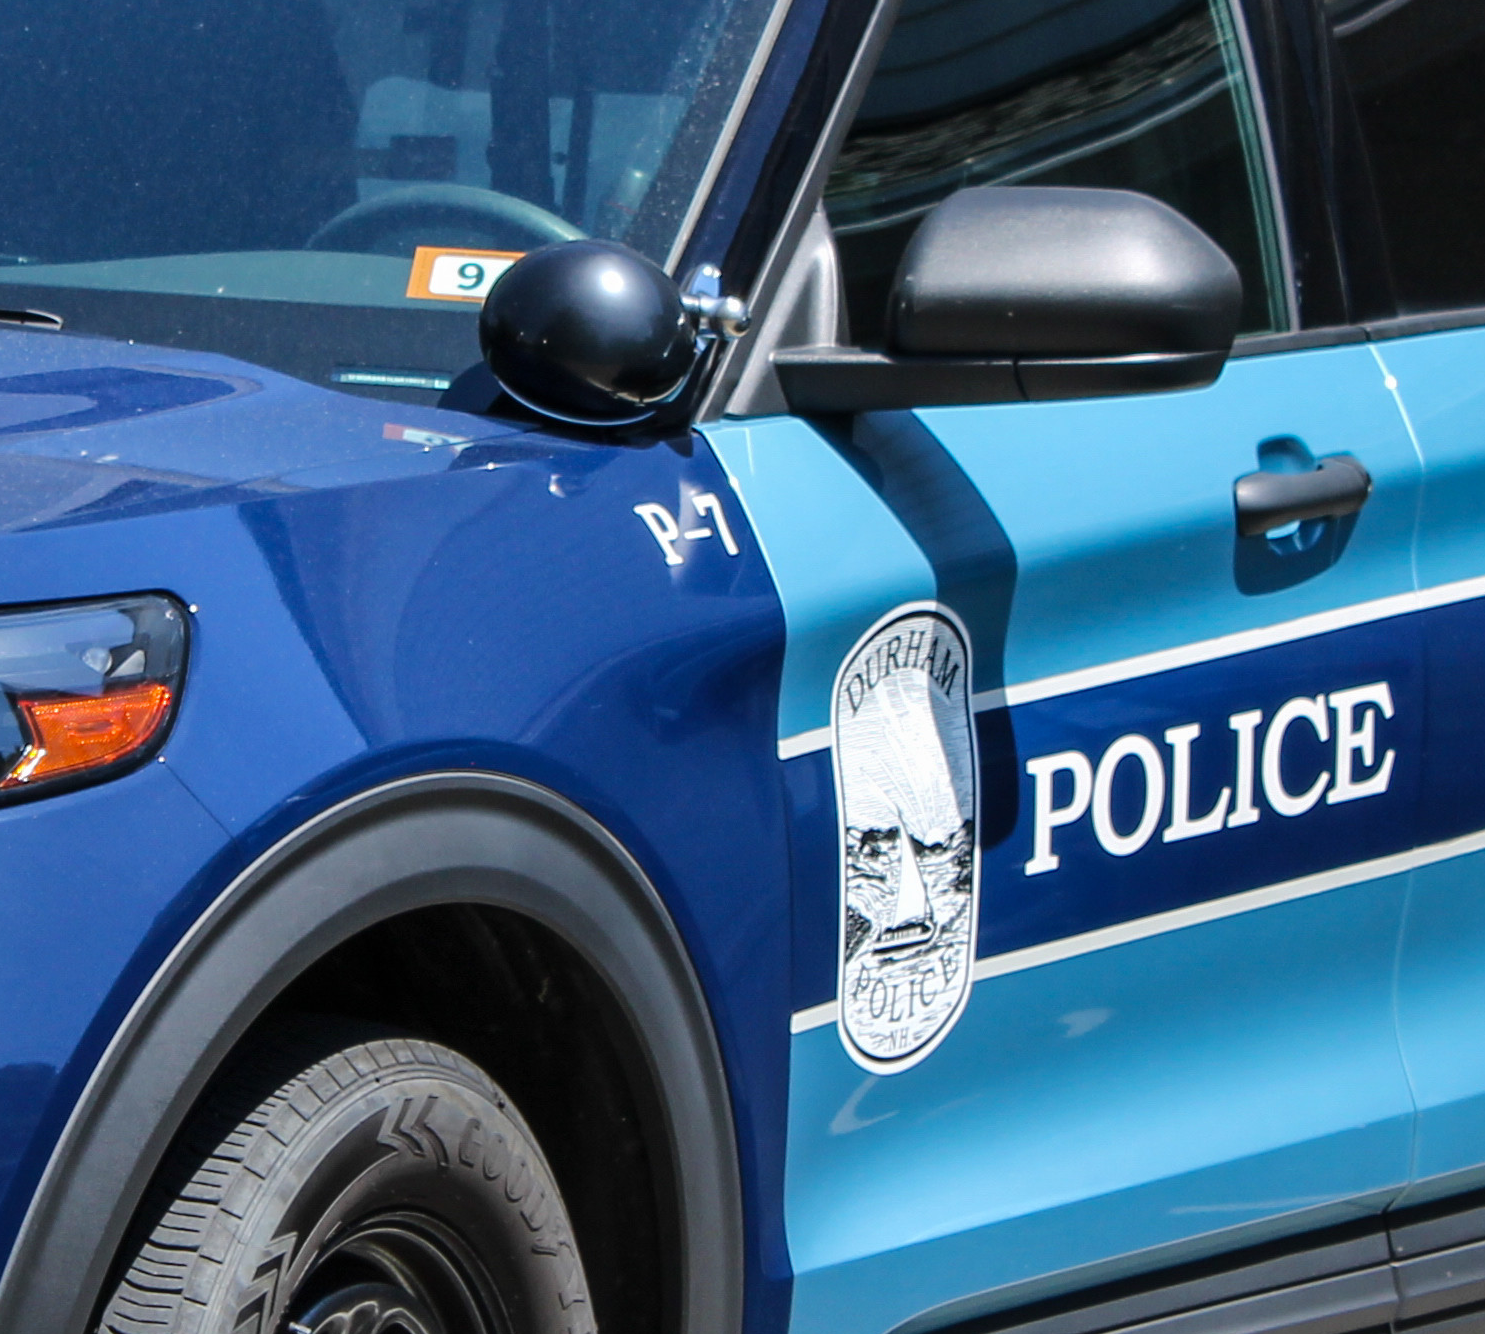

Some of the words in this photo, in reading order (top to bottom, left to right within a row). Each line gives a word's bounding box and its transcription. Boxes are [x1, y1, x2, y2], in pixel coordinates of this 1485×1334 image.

[456, 262, 485, 290] 9
[633, 493, 740, 566] P-7
[845, 629, 960, 718] DURHAM
[1024, 681, 1396, 877] POLICE
[853, 942, 959, 1024] POLICE
